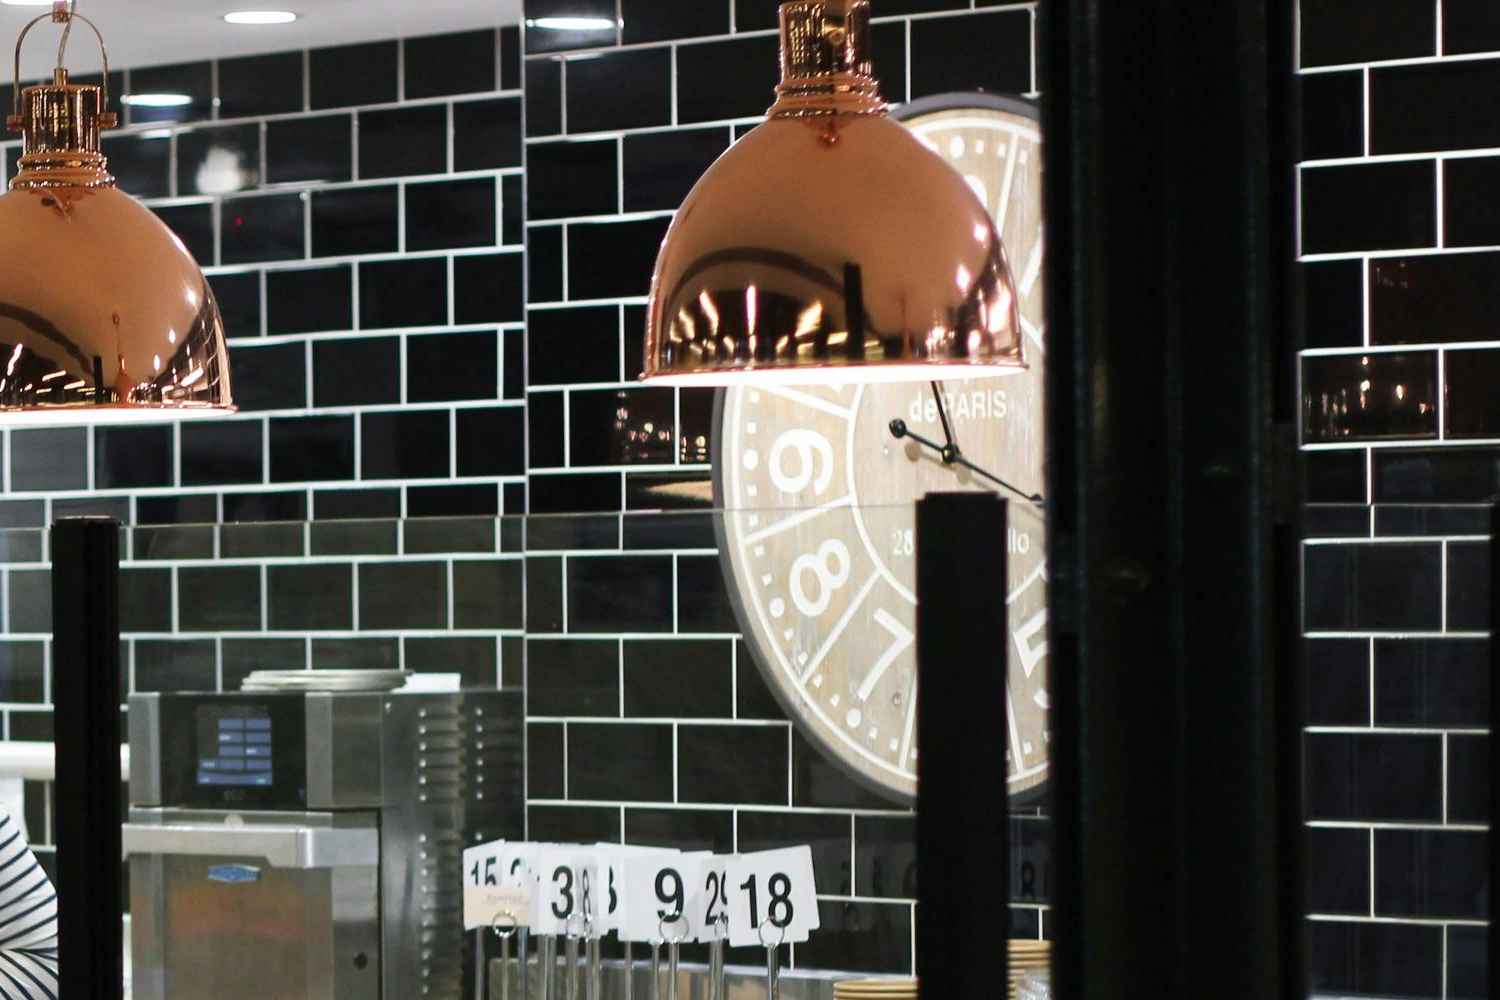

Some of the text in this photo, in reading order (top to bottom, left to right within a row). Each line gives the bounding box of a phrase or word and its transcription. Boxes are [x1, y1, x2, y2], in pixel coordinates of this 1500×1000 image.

[908, 389, 1007, 422] de PARIS
[551, 865, 574, 919] 3
[654, 867, 684, 923] 9
[740, 872, 794, 929] 18
